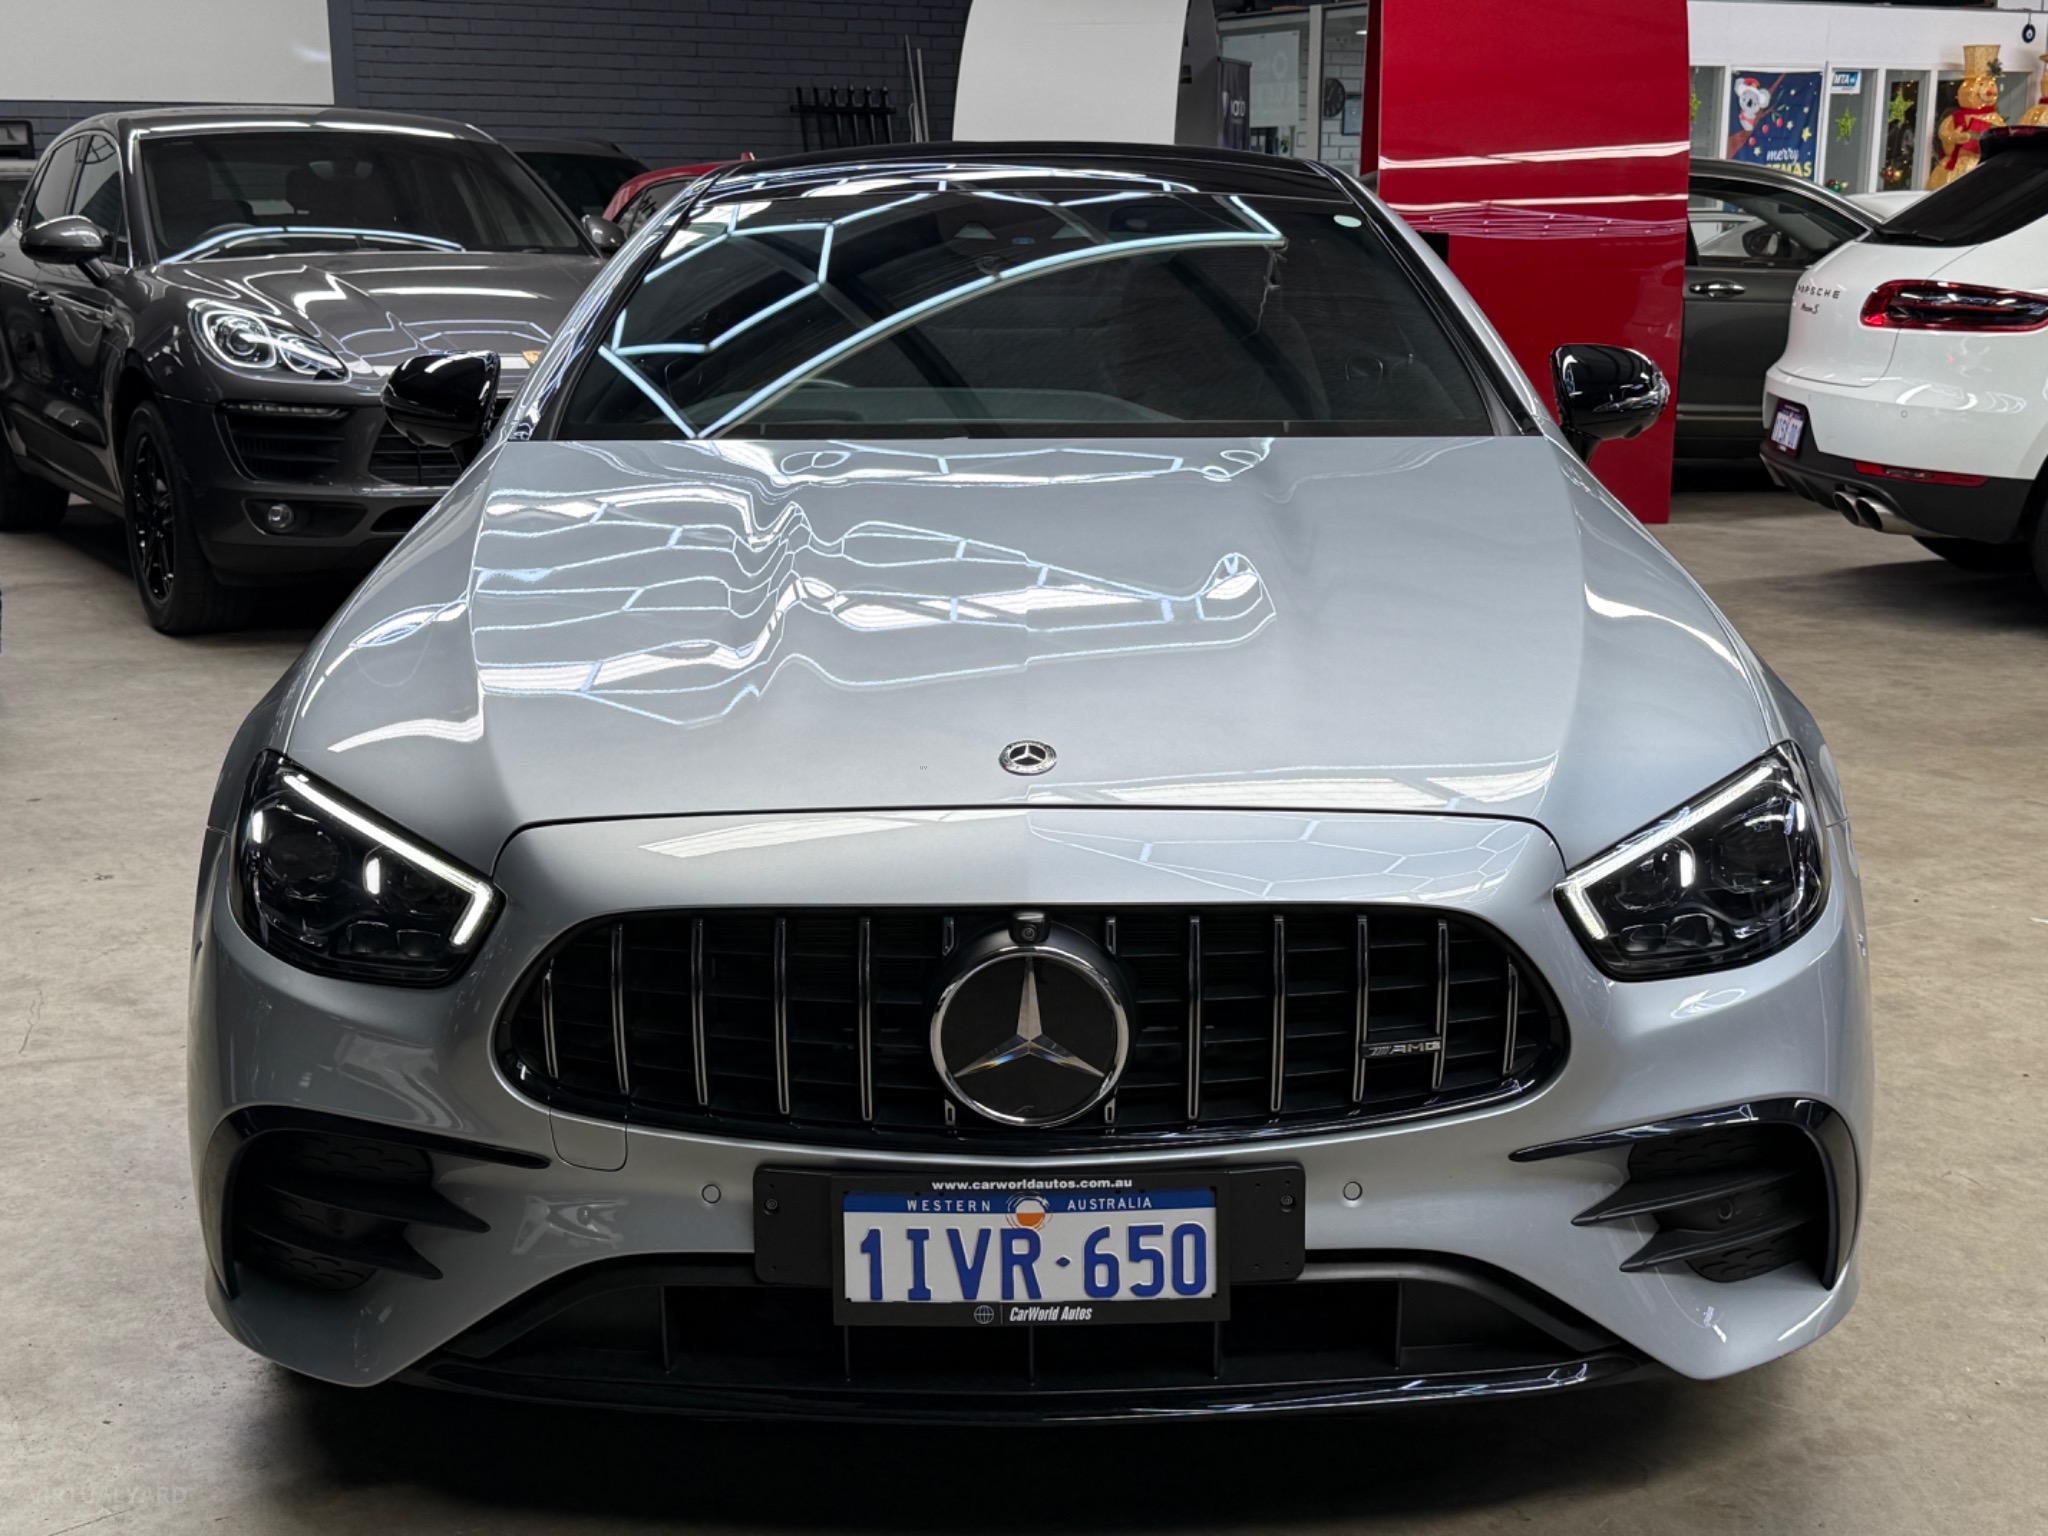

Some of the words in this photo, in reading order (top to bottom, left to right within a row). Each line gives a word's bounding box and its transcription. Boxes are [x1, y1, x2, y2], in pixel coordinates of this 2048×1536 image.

[1766, 147, 1799, 166] merry
[932, 1178, 1133, 1191] www.carworldautos.com.au
[906, 1199, 991, 1213] WESTERN
[1067, 1196, 1153, 1211] AUSTRALIA
[1009, 1305, 1060, 1322] CarWorld
[1060, 1303, 1093, 1321] Autos
